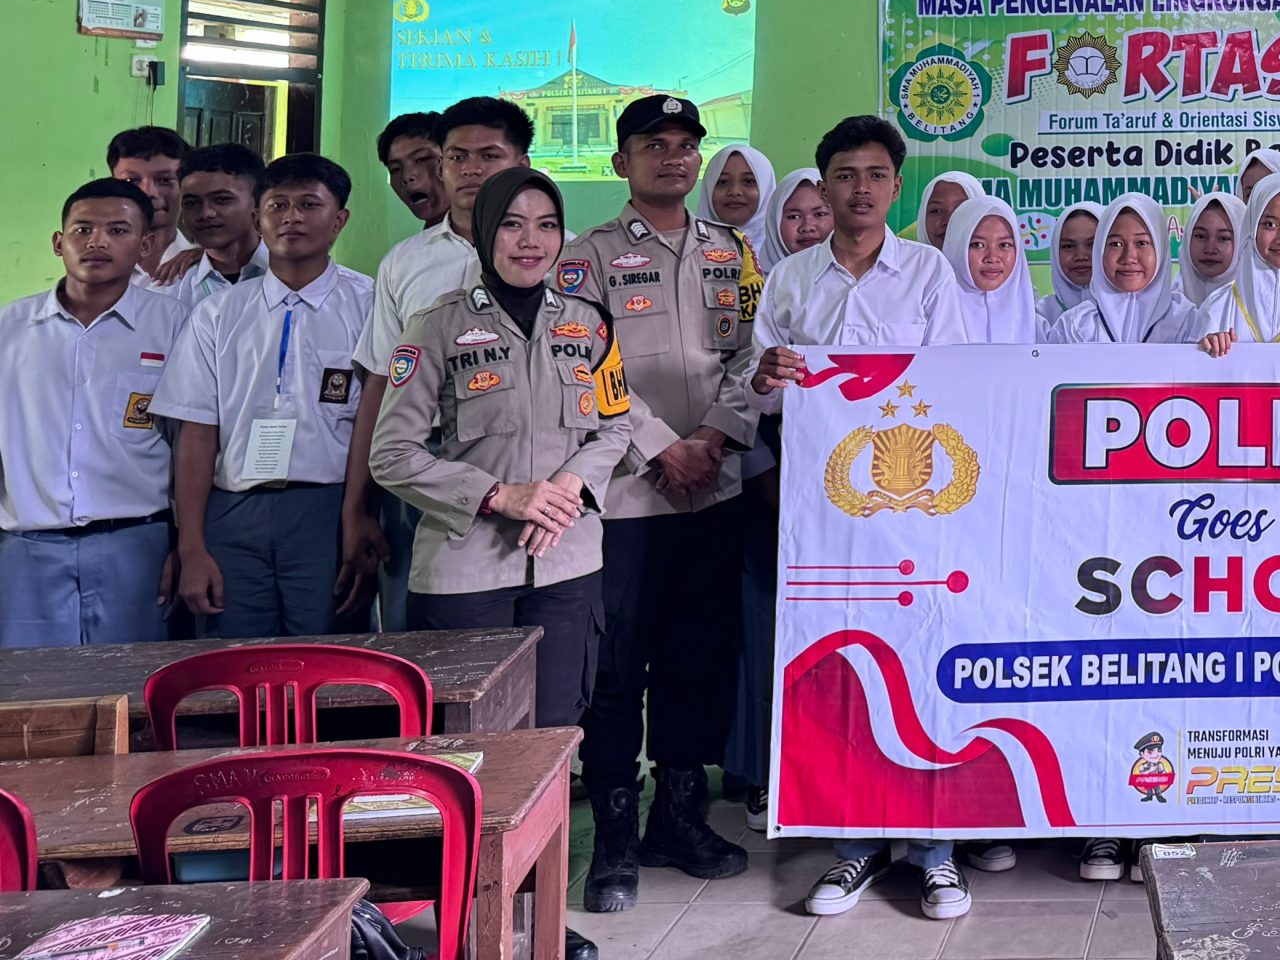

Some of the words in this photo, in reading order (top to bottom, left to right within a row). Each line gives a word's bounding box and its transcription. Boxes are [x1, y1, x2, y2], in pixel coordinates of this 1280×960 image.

[396, 29, 472, 46] SEKIAN
[479, 28, 493, 45] &
[398, 52, 478, 69] TERIMA
[485, 50, 551, 67] KASIH
[901, 79, 912, 99] SMA
[909, 57, 980, 90] MUHAMMADIYAH
[908, 112, 974, 134] BELITANG
[1050, 113, 1097, 130] Forum
[1106, 112, 1156, 129] Ta'aruf
[1163, 113, 1174, 128] &
[1180, 111, 1248, 128] Orientasi
[1010, 140, 1143, 168] Peserta
[1155, 138, 1233, 166] Didik
[1019, 175, 1238, 208] MUHAMMADIYA
[447, 350, 479, 372] TRI
[1168, 493, 1275, 542] Goes
[954, 655, 1072, 689] POLSEK
[1081, 652, 1226, 686] BELITANG
[1187, 729, 1269, 742] TRANSFORMASI
[1188, 746, 1231, 759] MENUJU
[1235, 746, 1265, 758] POLRI
